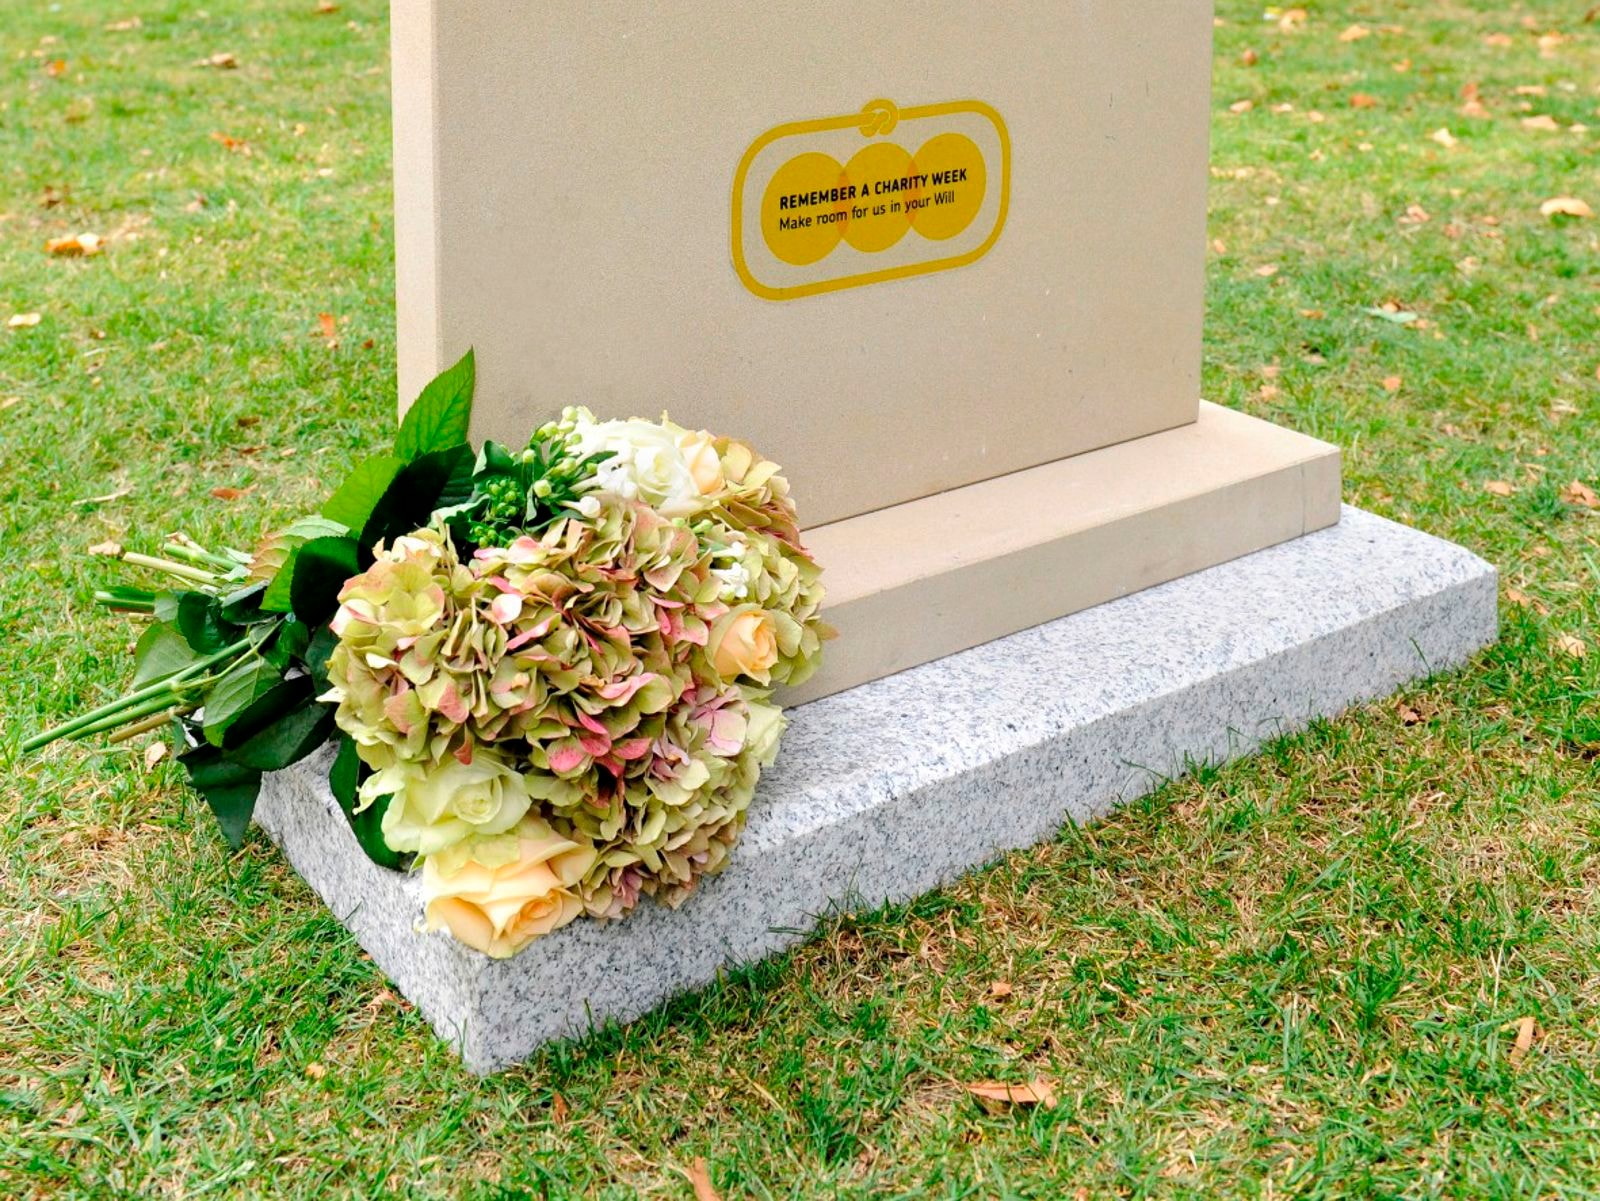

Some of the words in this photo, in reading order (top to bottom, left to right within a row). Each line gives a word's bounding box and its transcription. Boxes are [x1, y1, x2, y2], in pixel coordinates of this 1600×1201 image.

[780, 185, 856, 210] REMEMBER
[861, 183, 870, 197] A
[874, 174, 928, 195] CHARITY
[932, 168, 967, 185] WEEK
[779, 216, 812, 231] Make
[816, 210, 847, 225] room
[852, 205, 868, 219] for
[873, 203, 886, 216] us
[891, 200, 900, 213] in
[904, 197, 930, 213] your
[934, 190, 955, 206] Will
